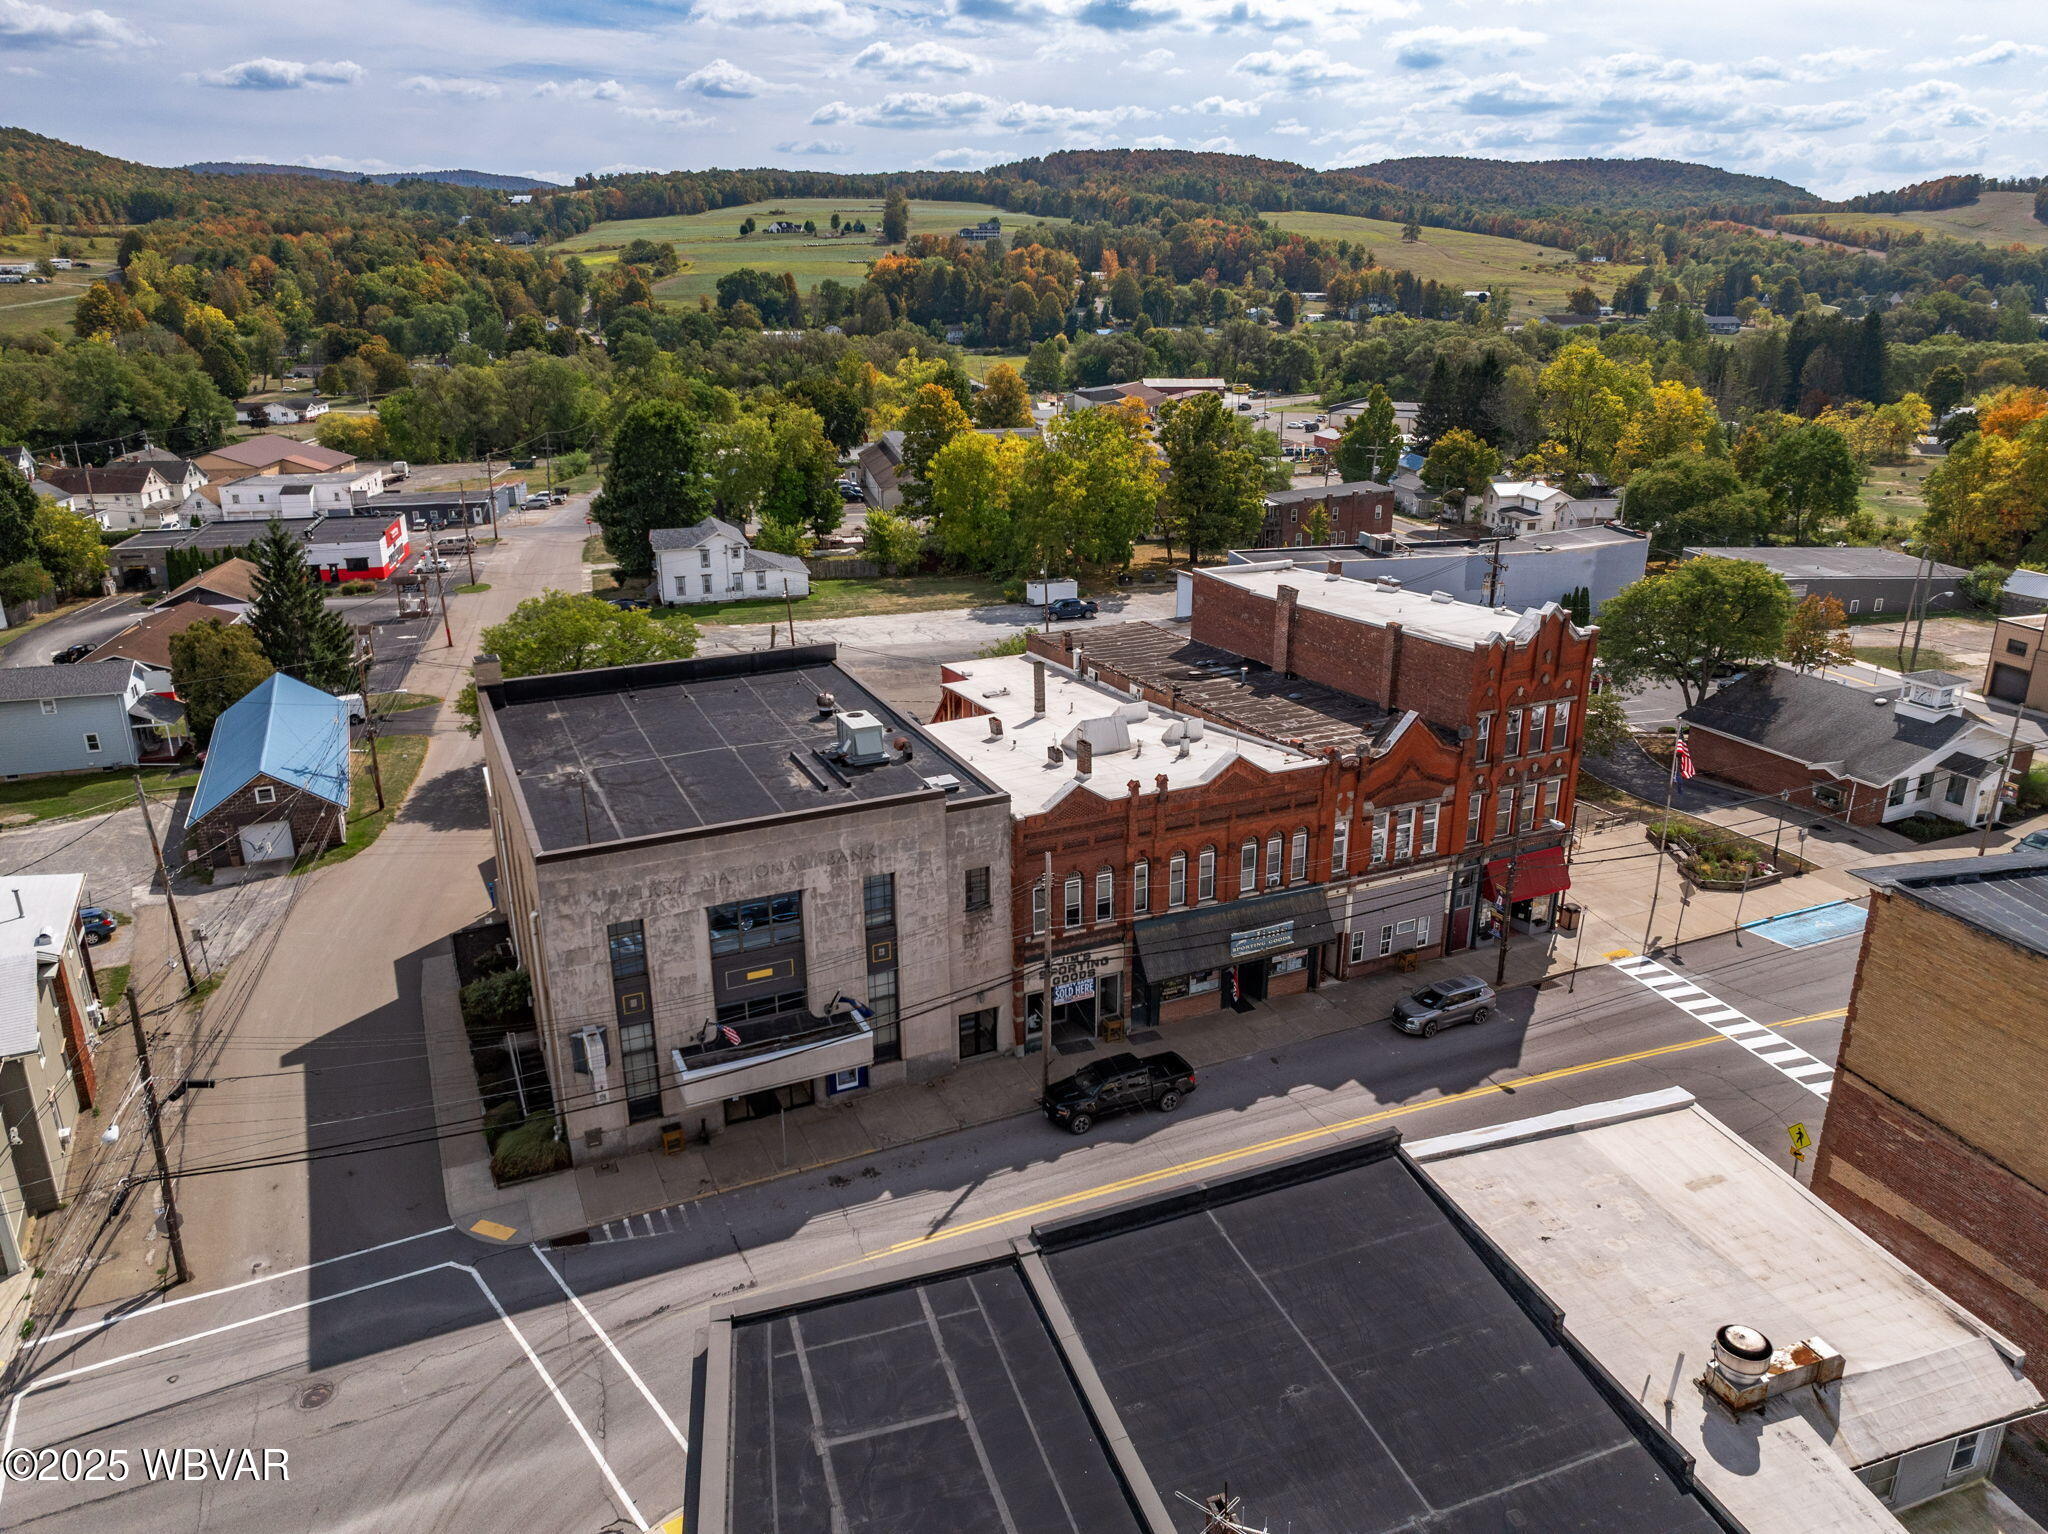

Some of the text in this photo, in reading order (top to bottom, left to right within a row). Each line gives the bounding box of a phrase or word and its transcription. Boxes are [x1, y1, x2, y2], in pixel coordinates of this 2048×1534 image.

[826, 844, 876, 865] BANK
[1232, 936, 1291, 952] SPORTING GOODS
[1053, 968, 1096, 985] GOODS
[1055, 987, 1074, 1000] SOLD
[1075, 983, 1094, 996] HERE
